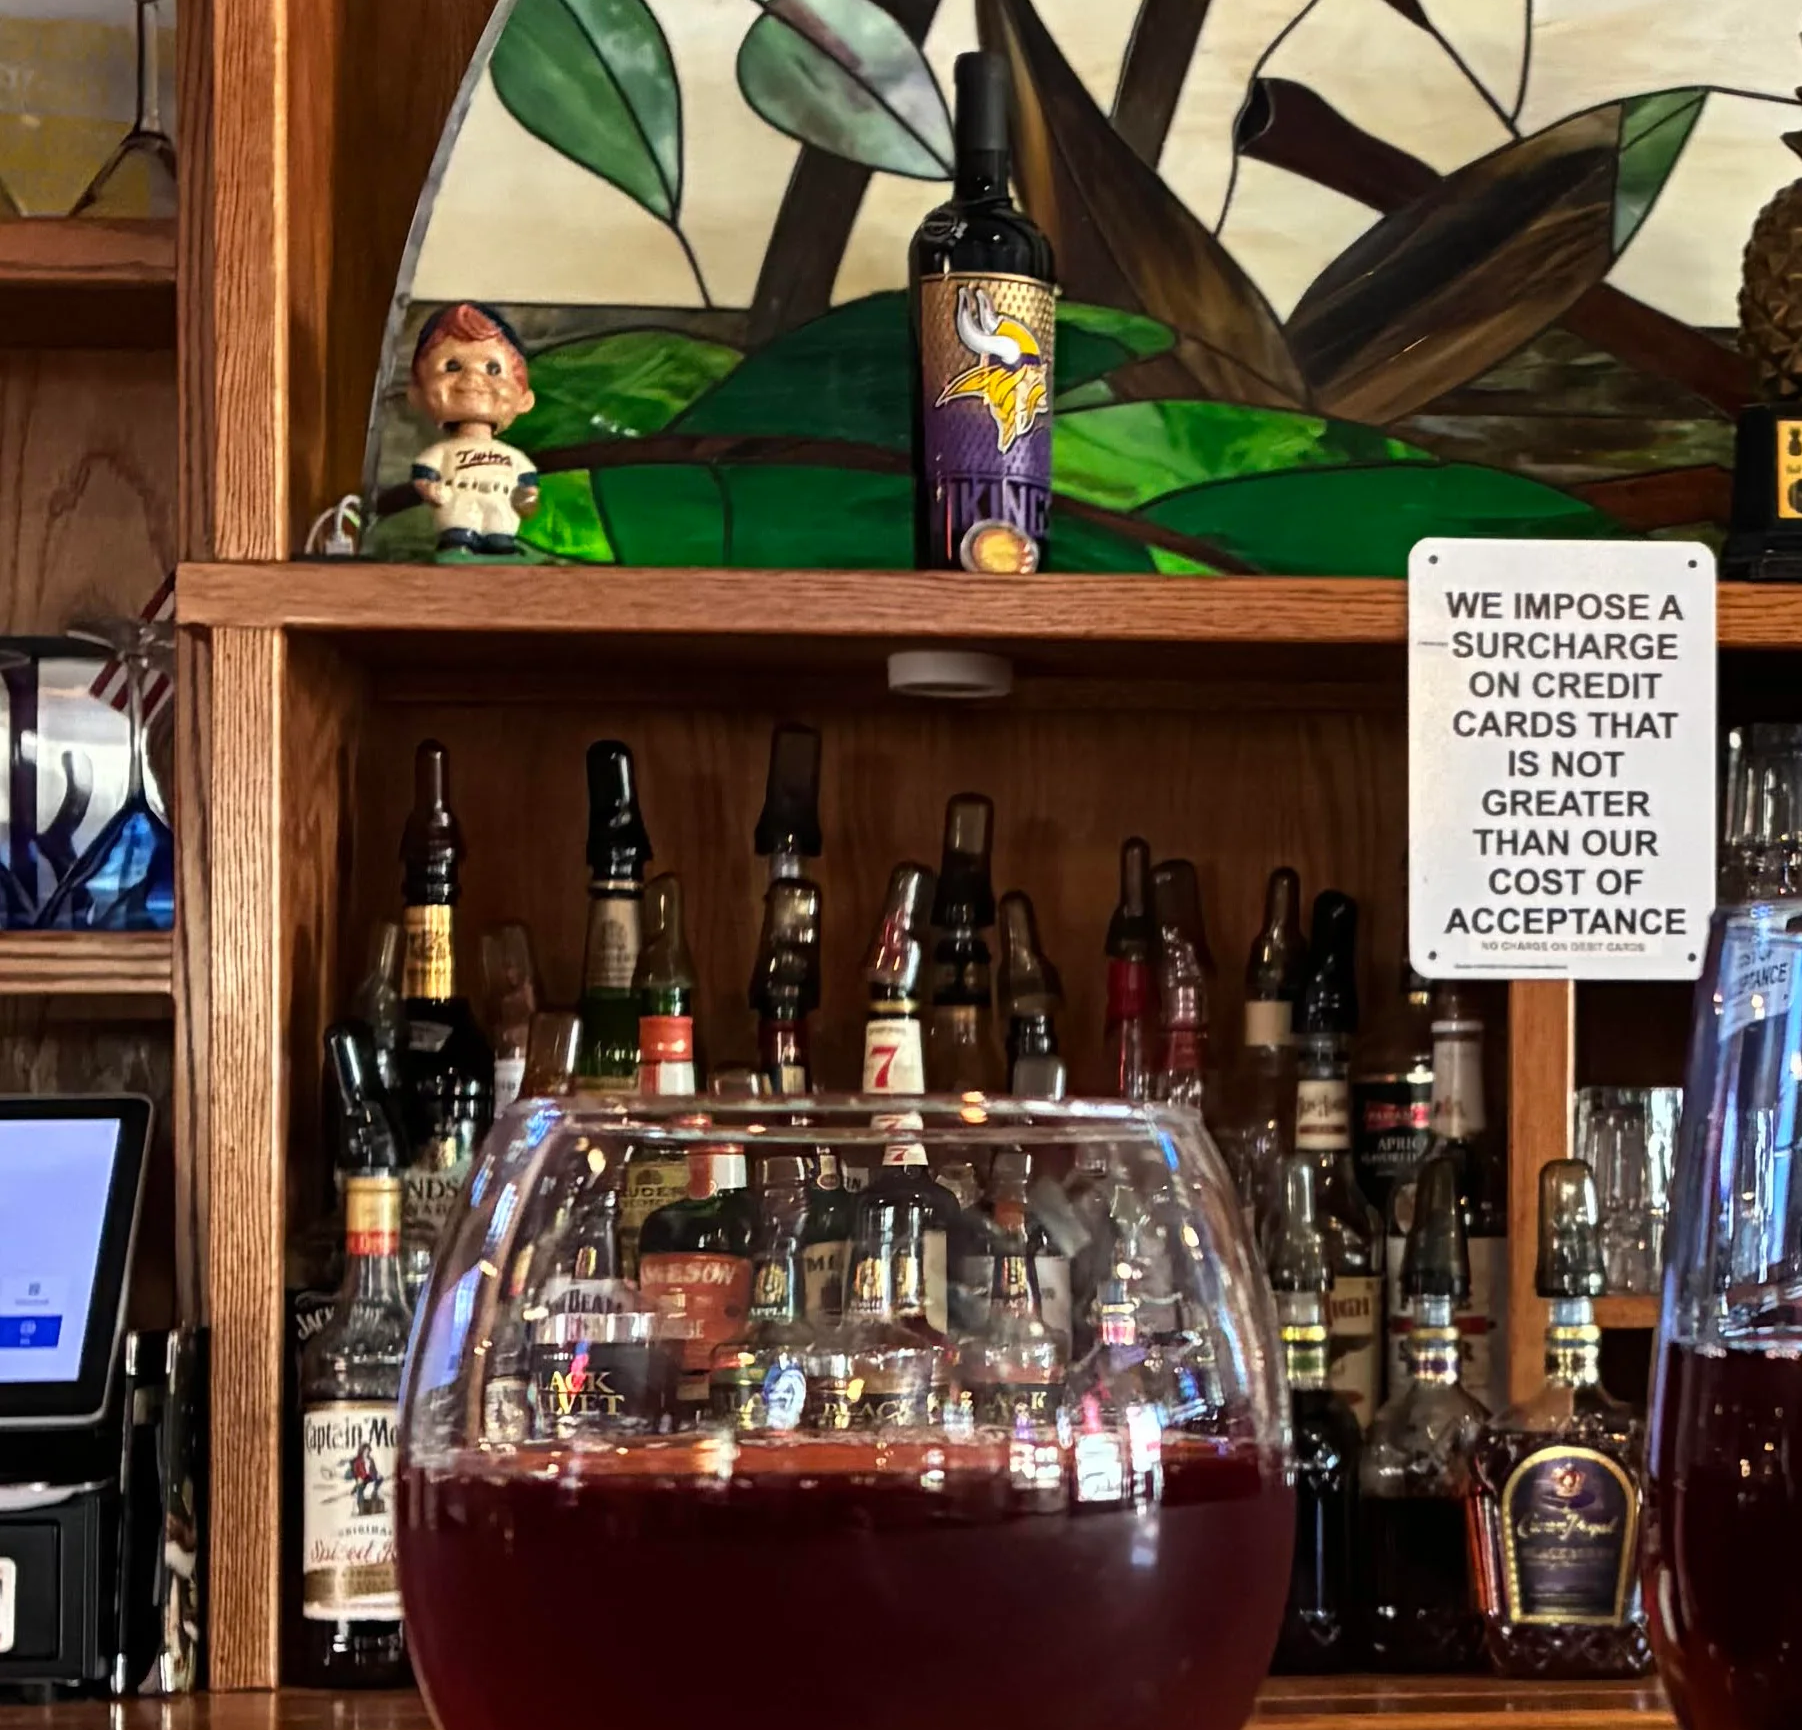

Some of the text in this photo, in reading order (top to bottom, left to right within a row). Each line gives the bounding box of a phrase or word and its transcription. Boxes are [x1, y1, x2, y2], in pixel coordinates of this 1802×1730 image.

[1446, 591, 1684, 620] WE IMPOSE A
[1452, 631, 1679, 661] SURCHARGE
[1469, 671, 1663, 699] ON CREDIT
[1453, 711, 1679, 739] CARDS THAT
[1507, 750, 1626, 778] IS NOT
[1481, 790, 1651, 818] GREATER
[1473, 829, 1659, 857] THAN OUR
[1488, 868, 1645, 896] COST OF
[1443, 907, 1688, 935] ACCEPTANCE
[1480, 941, 1646, 953] NO CHARGE ON DEBIT CARDS
[871, 1045, 899, 1088] 7
